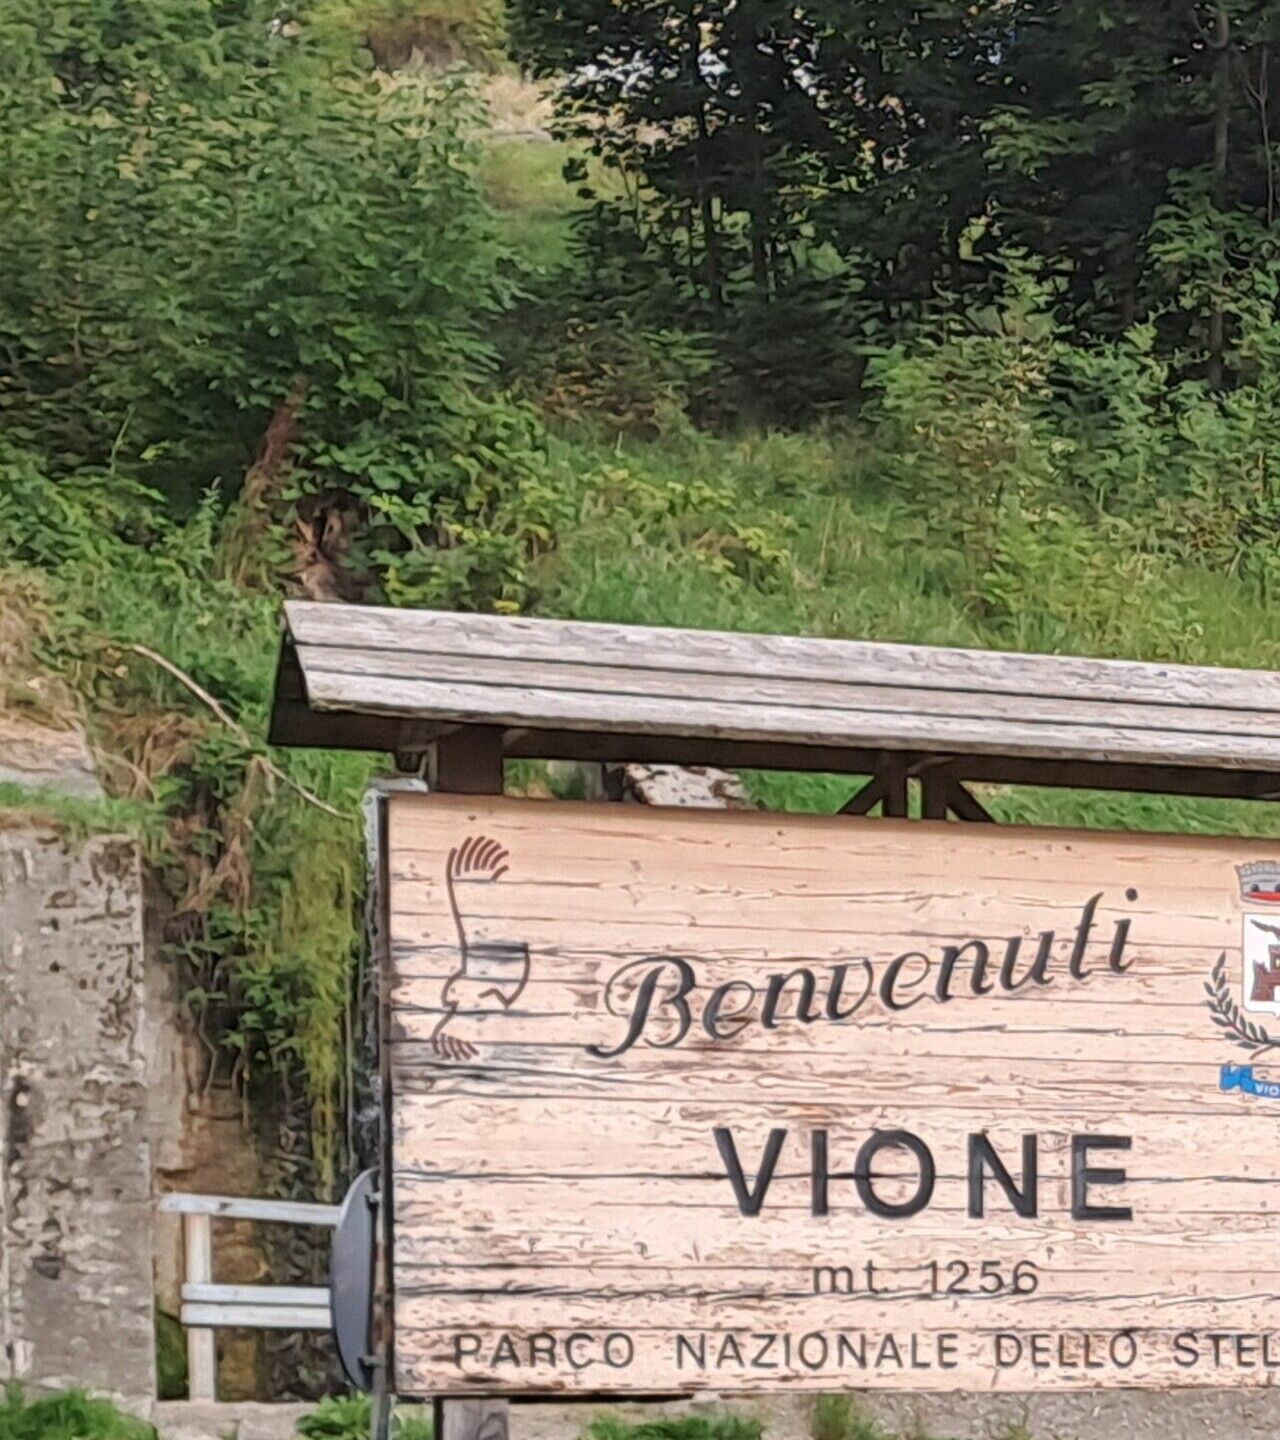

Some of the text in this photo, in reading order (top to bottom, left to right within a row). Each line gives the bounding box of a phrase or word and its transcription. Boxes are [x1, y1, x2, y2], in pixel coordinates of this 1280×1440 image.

[585, 887, 1138, 1057] Benvenuti
[713, 1127, 1134, 1221] VIONE
[918, 1260, 1039, 1294] 1256
[453, 1332, 635, 1369] PARCO
[676, 1330, 958, 1370] NAZIONALE
[995, 1331, 1138, 1368] DELLO
